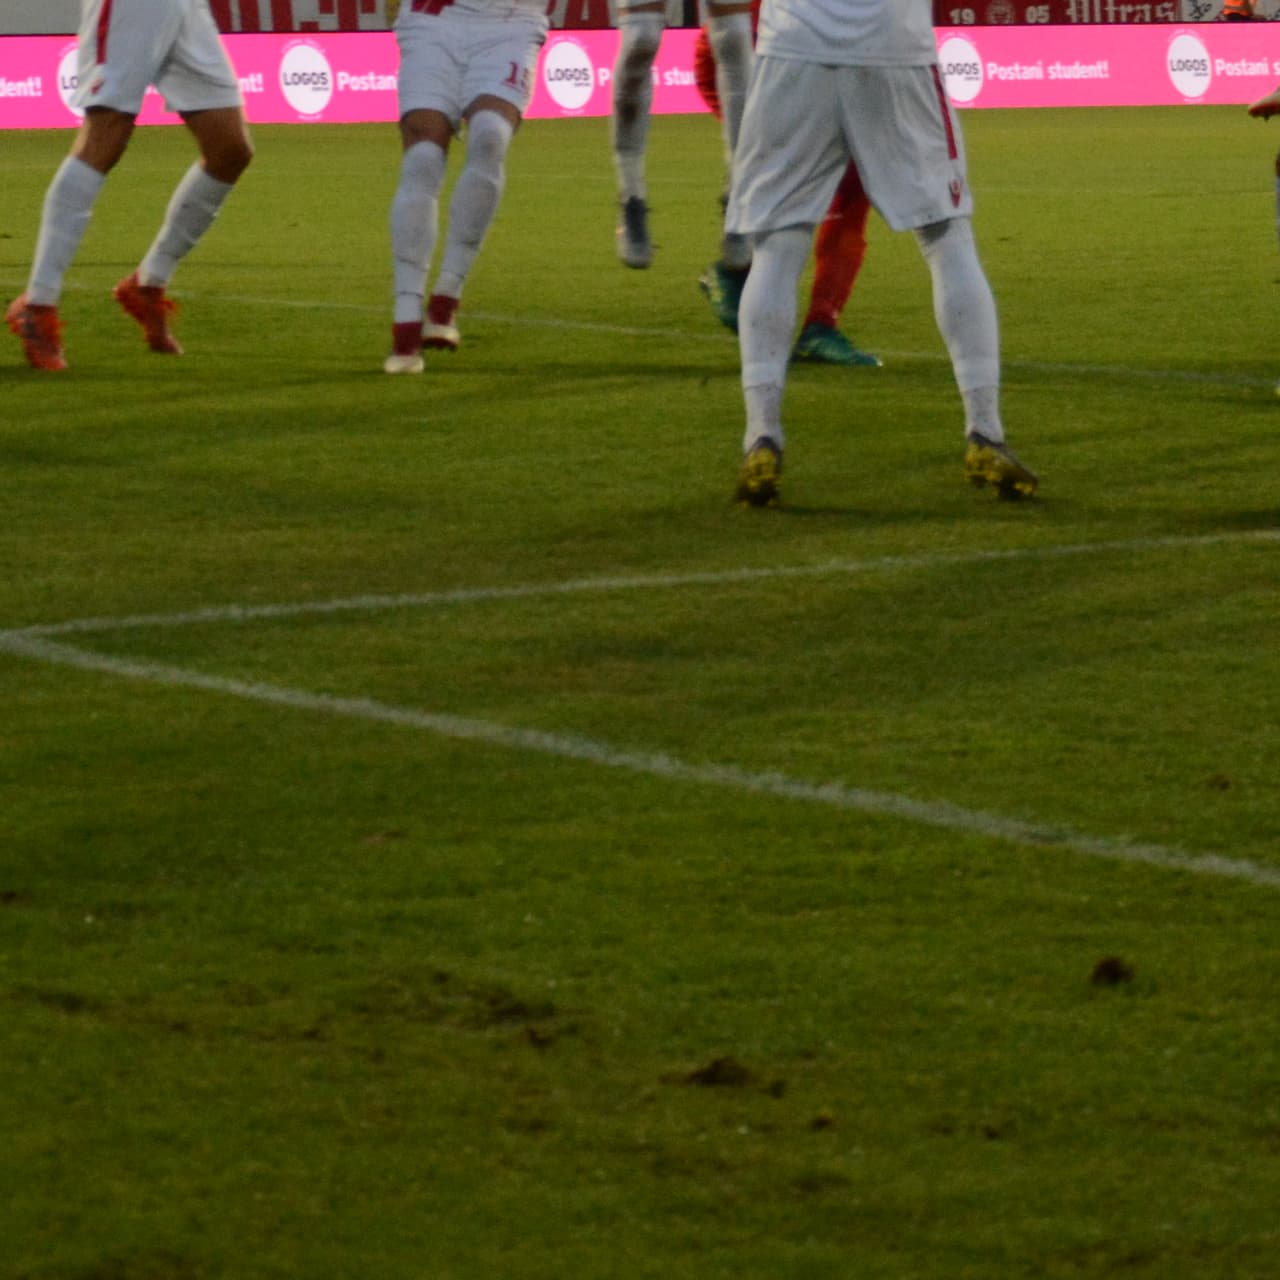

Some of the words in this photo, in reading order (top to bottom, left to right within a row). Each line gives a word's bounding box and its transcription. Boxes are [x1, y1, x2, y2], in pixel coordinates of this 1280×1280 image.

[949, 8, 975, 24] 19
[986, 61, 1044, 80] Postani
[1047, 60, 1109, 79] student!
[1170, 59, 1207, 71] LOGOS
[1215, 57, 1269, 76] Postani
[283, 72, 328, 86] LOGOS
[548, 68, 590, 81] LOGOS
